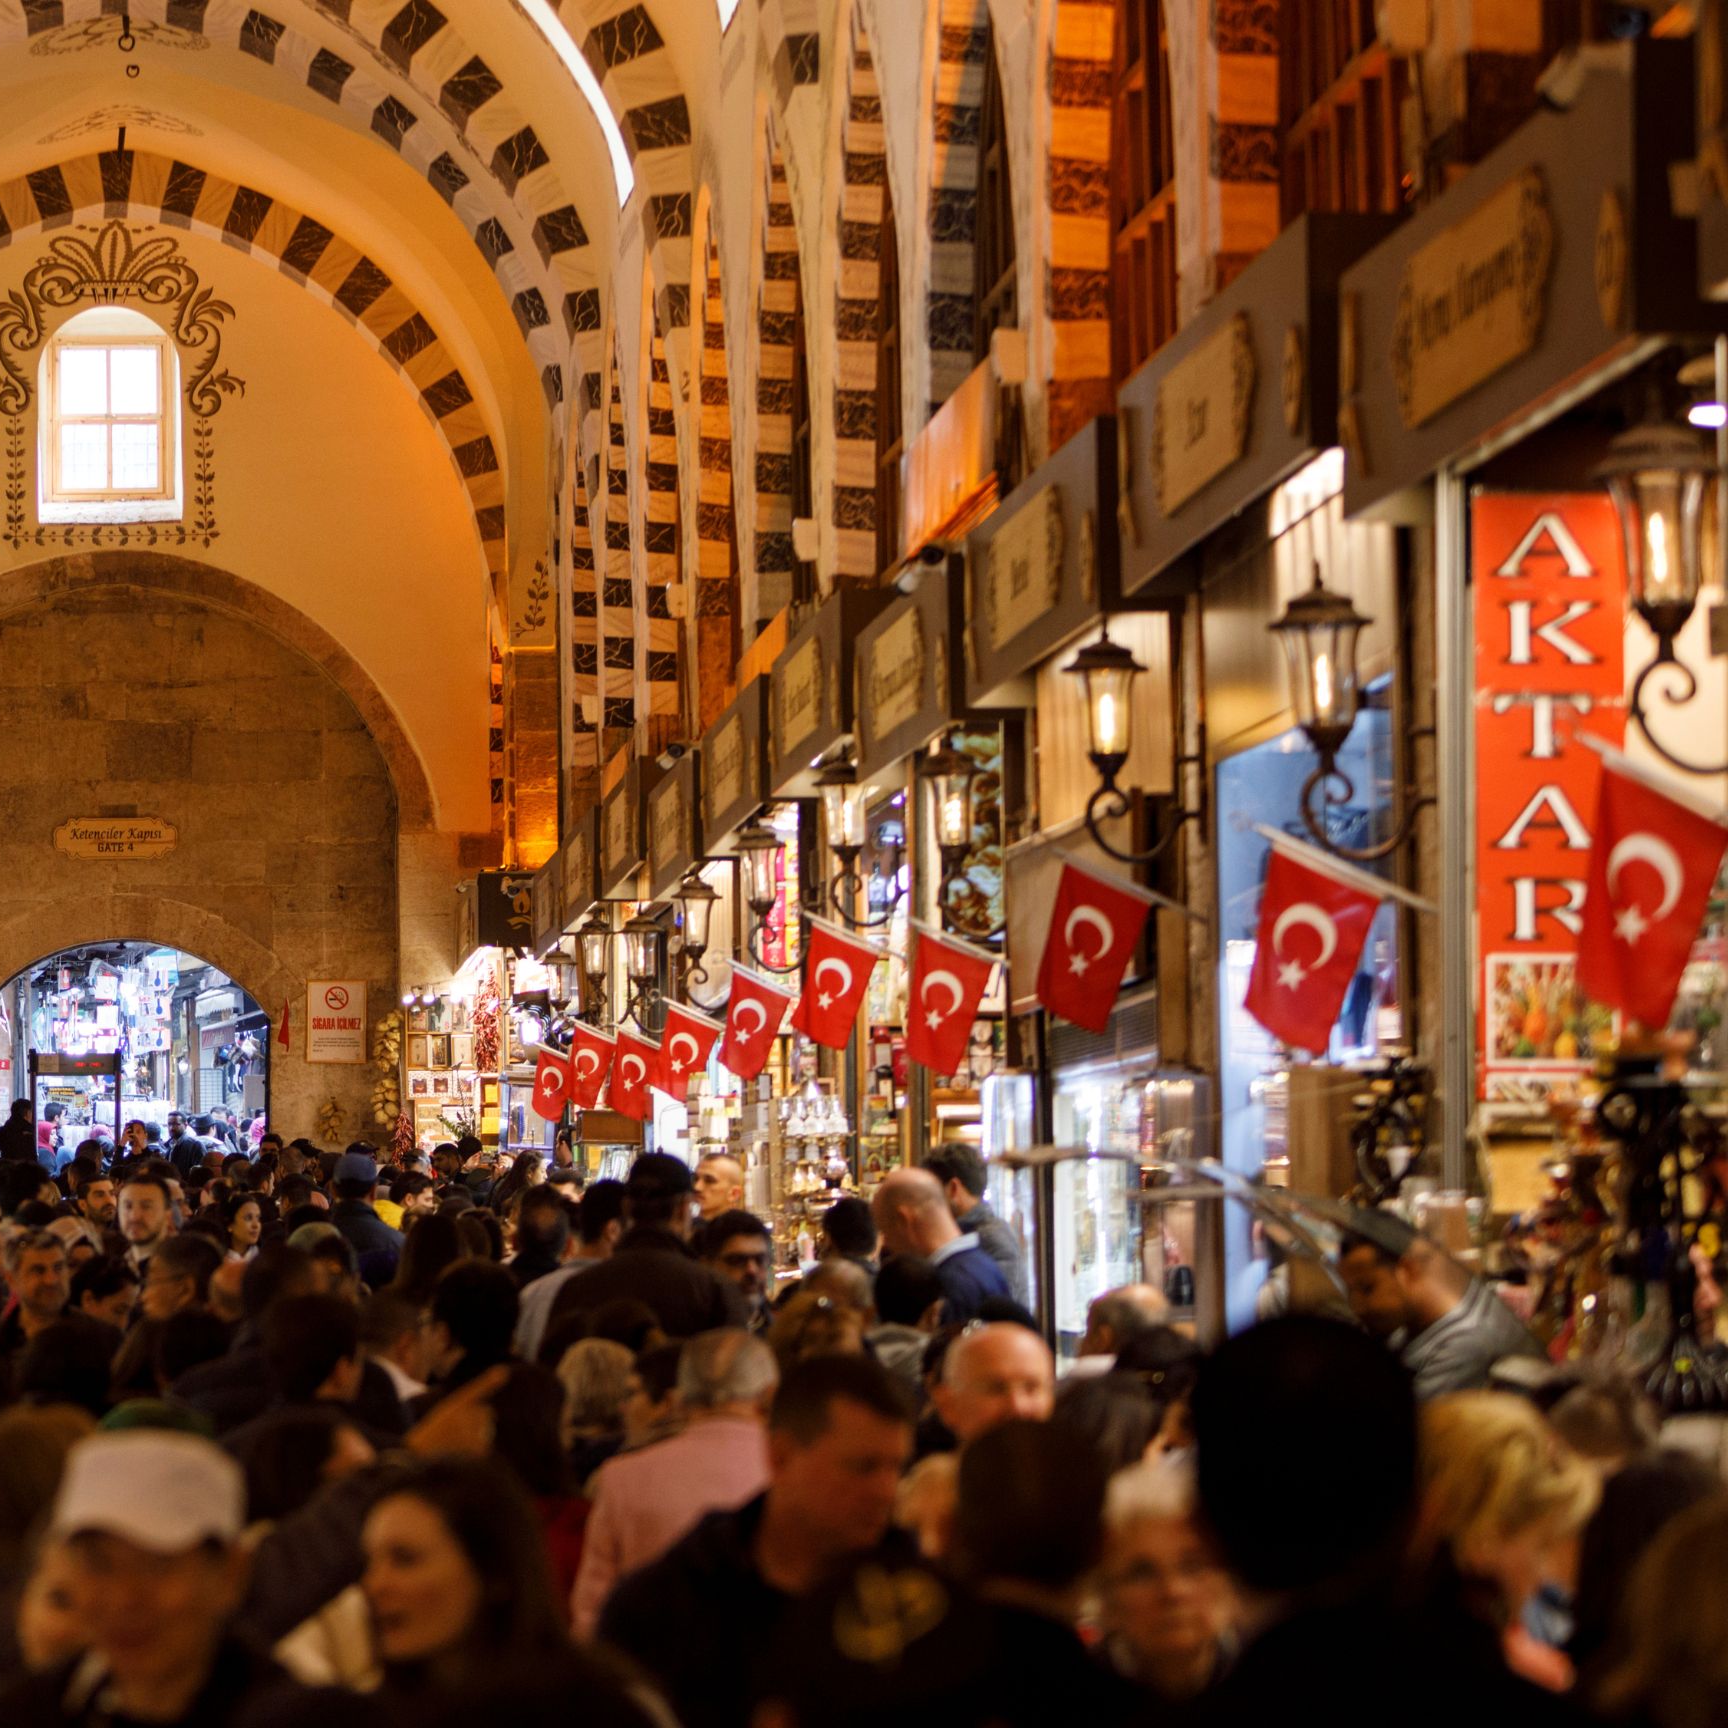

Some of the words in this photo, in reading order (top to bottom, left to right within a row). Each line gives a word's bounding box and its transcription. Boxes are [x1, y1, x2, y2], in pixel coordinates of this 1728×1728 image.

[1489, 512, 1604, 942] AKTAR
[70, 826, 124, 840] Ketenciler
[127, 827, 162, 844] Kapısı
[97, 842, 124, 853] GATE
[127, 842, 134, 852] 4
